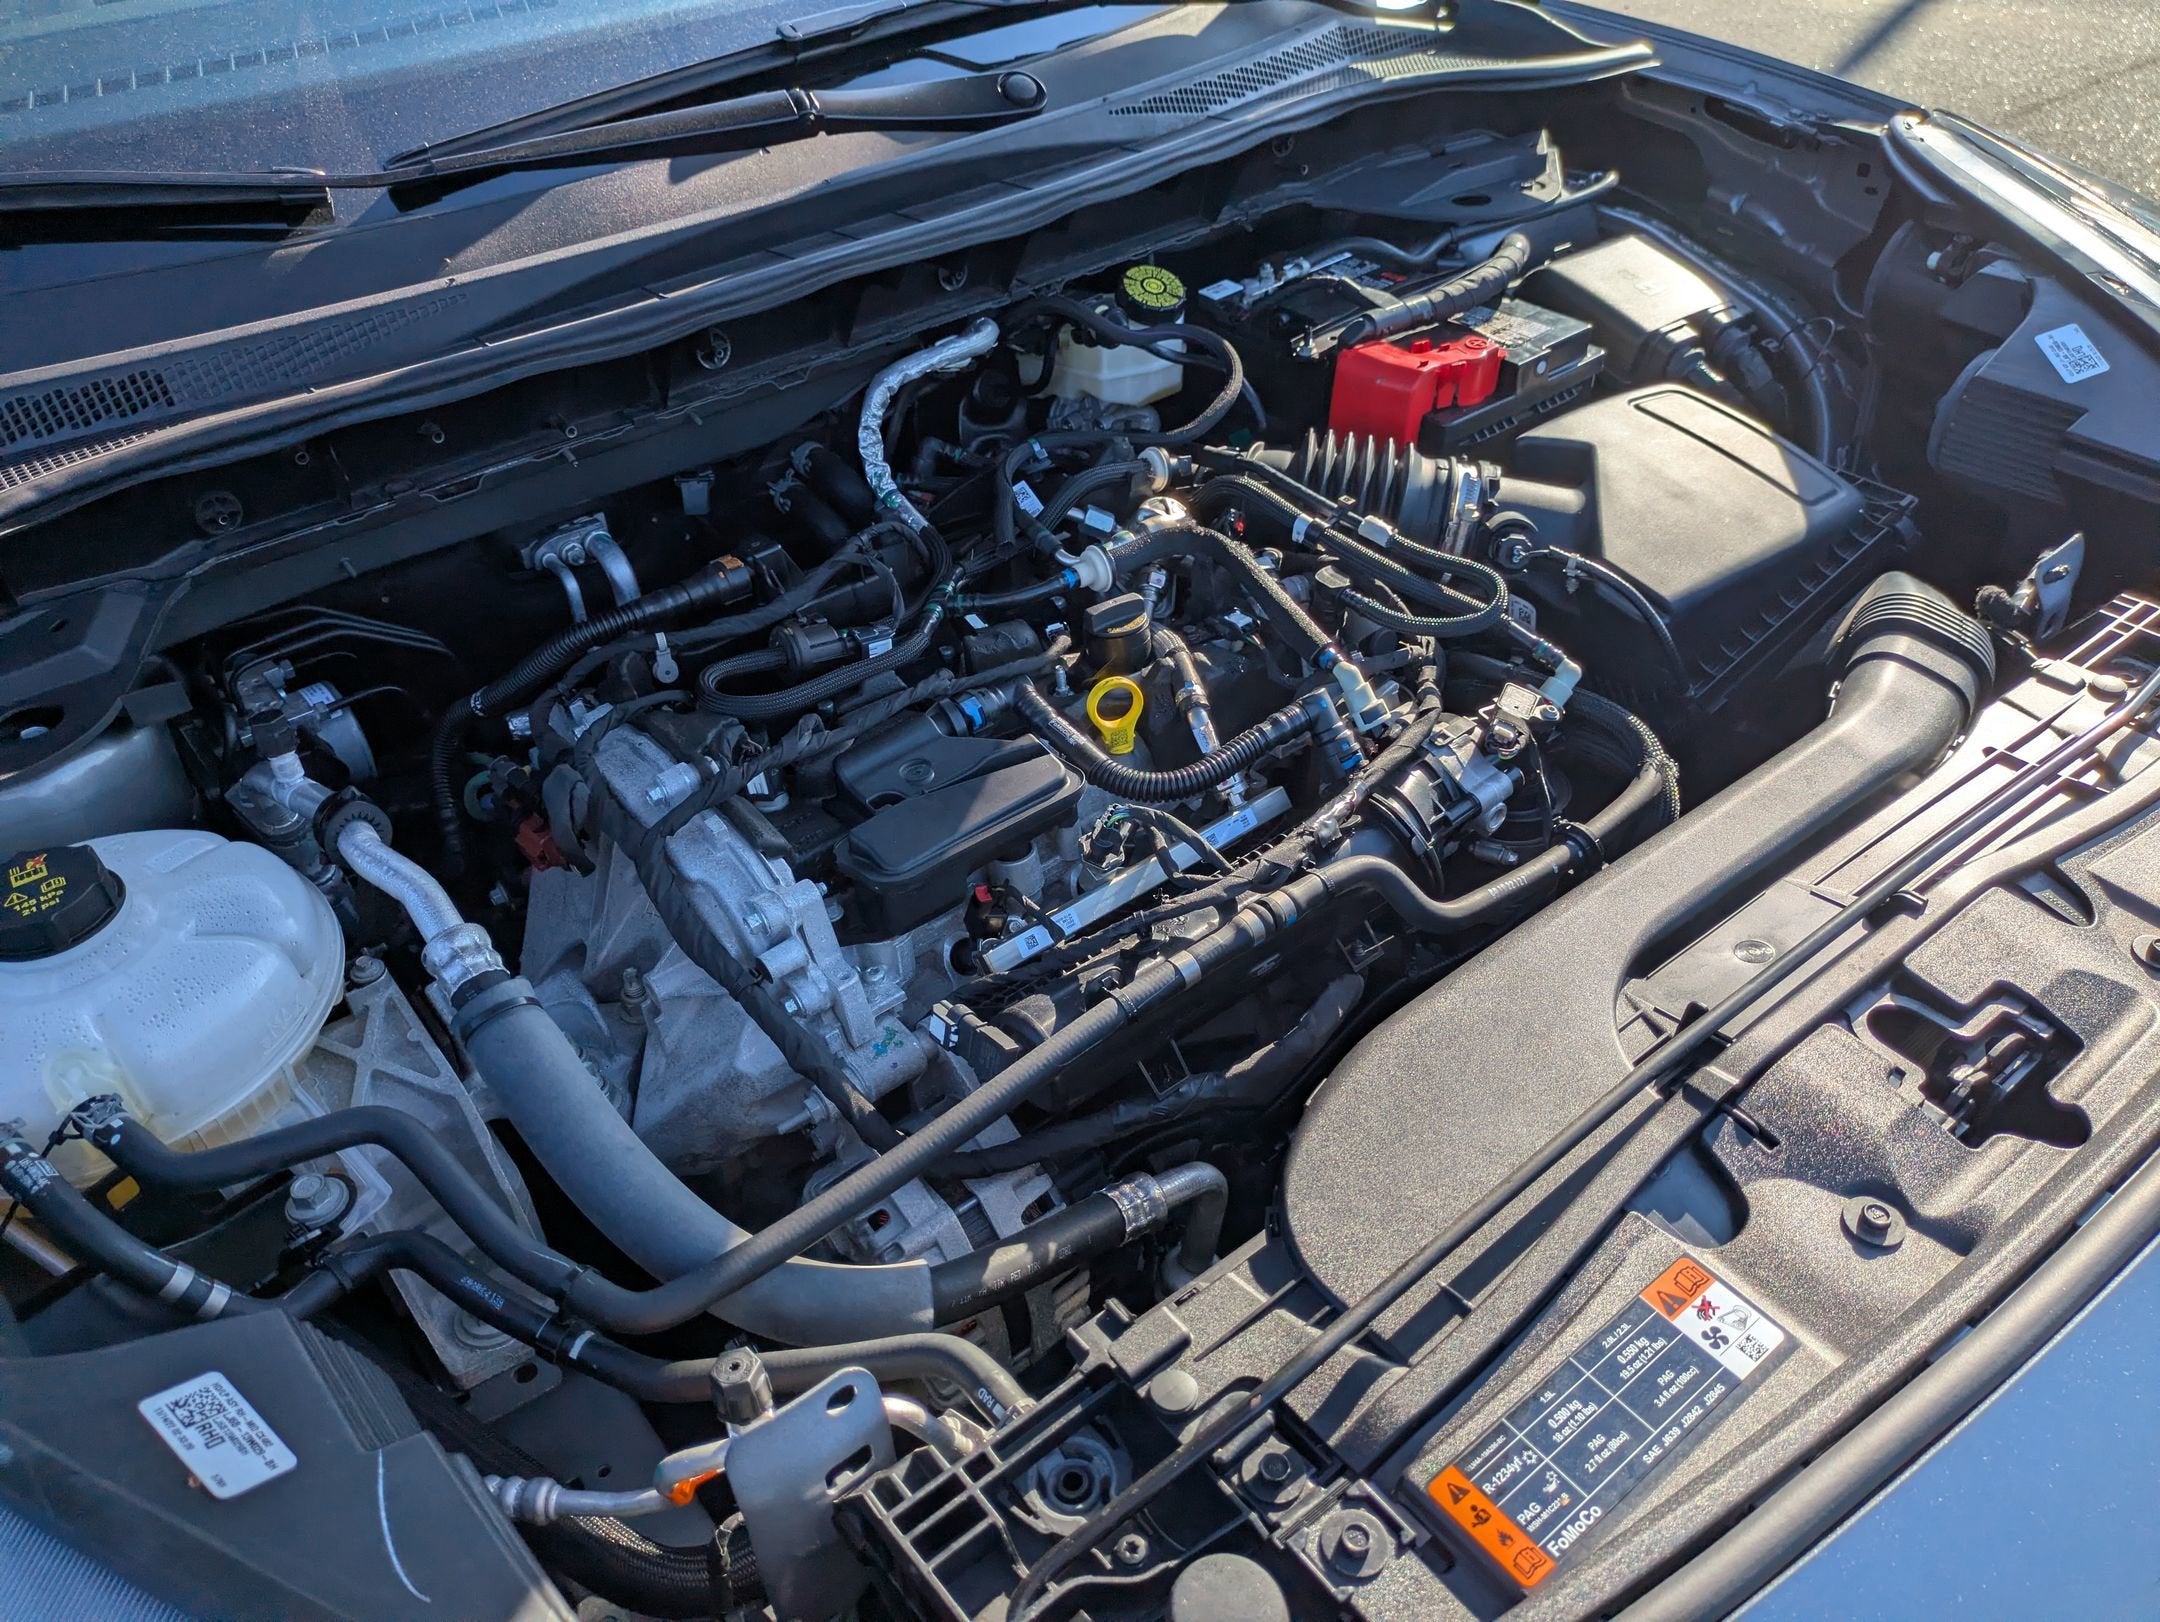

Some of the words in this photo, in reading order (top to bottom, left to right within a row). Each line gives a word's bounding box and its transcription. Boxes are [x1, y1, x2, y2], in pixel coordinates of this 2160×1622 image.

[40, 890, 64, 901] kPa
[41, 898, 60, 910] psi
[1616, 1342, 1639, 1365] 0.550
[1634, 1334, 1650, 1350] kg
[1618, 1364, 1635, 1380] 19.5
[1632, 1358, 1642, 1369] oz
[1651, 1335, 1667, 1352] lbs)
[1656, 1368, 1675, 1386] PAG
[977, 1387, 996, 1408] RAD
[1653, 1393, 1667, 1407] 3.4
[1662, 1389, 1671, 1398] fl
[1668, 1384, 1679, 1394] oz
[1546, 1405, 1571, 1429] 0.500
[1566, 1397, 1582, 1413] kg
[1561, 1426, 1571, 1436] oz
[1567, 1411, 1586, 1430] (1.10
[1581, 1400, 1598, 1417] lbs)
[1642, 1444, 1662, 1464] SAE
[1660, 1425, 1682, 1446] J639
[1678, 1404, 1703, 1428] J2842
[1701, 1382, 1725, 1405] J2845
[1584, 1458, 1598, 1473] 2.7
[1600, 1448, 1611, 1458] oz
[1606, 1430, 1630, 1453] (80cc)
[1587, 1432, 1605, 1451] PAG
[1481, 1455, 1525, 1497] R-1234yf
[1516, 1500, 1541, 1525] PAG
[1546, 1503, 1602, 1557] FoMoCo
